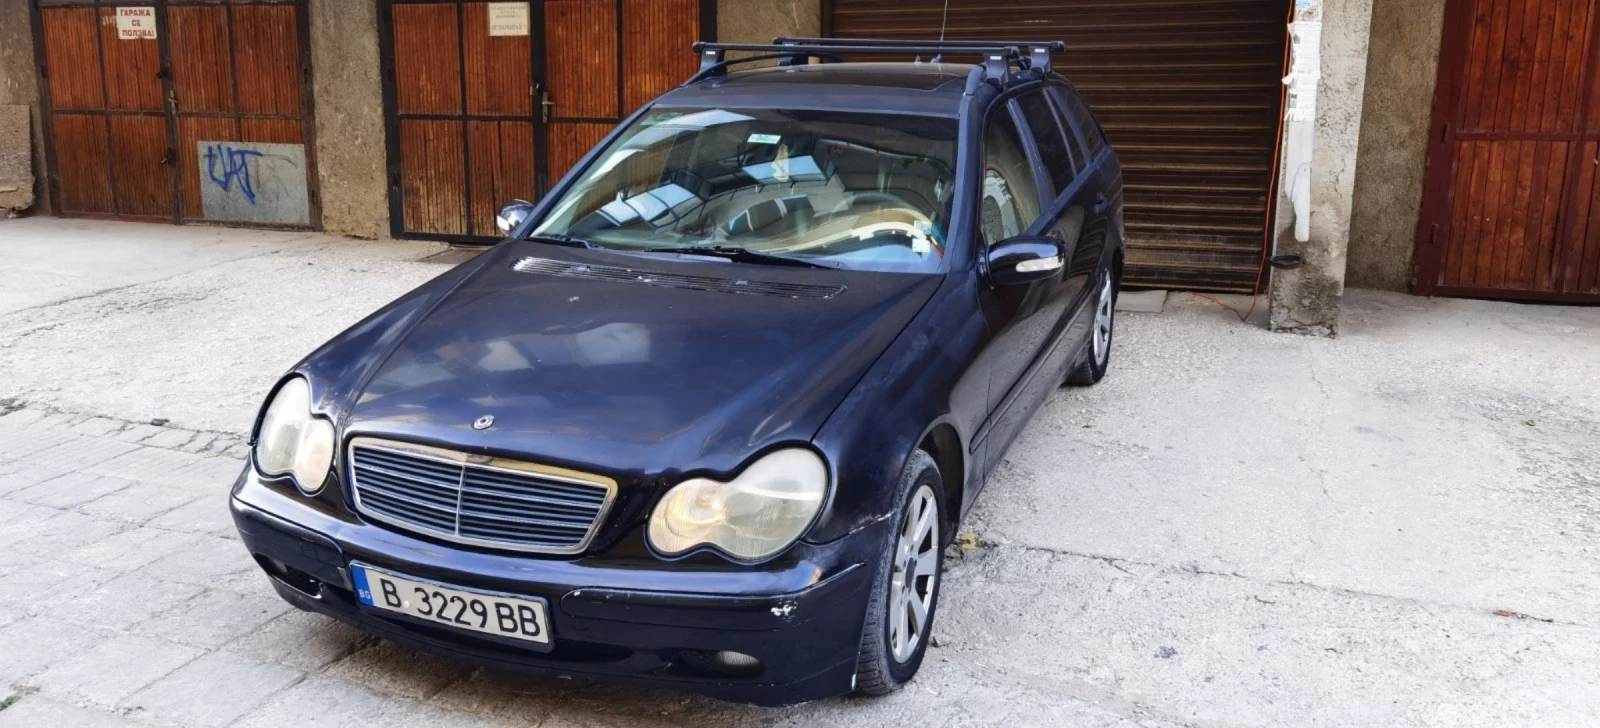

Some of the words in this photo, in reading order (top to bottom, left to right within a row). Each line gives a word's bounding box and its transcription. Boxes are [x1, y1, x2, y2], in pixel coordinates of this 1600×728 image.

[359, 589, 371, 600] BG
[380, 578, 402, 608] B
[414, 587, 488, 629] 3229
[495, 602, 541, 637] BB
